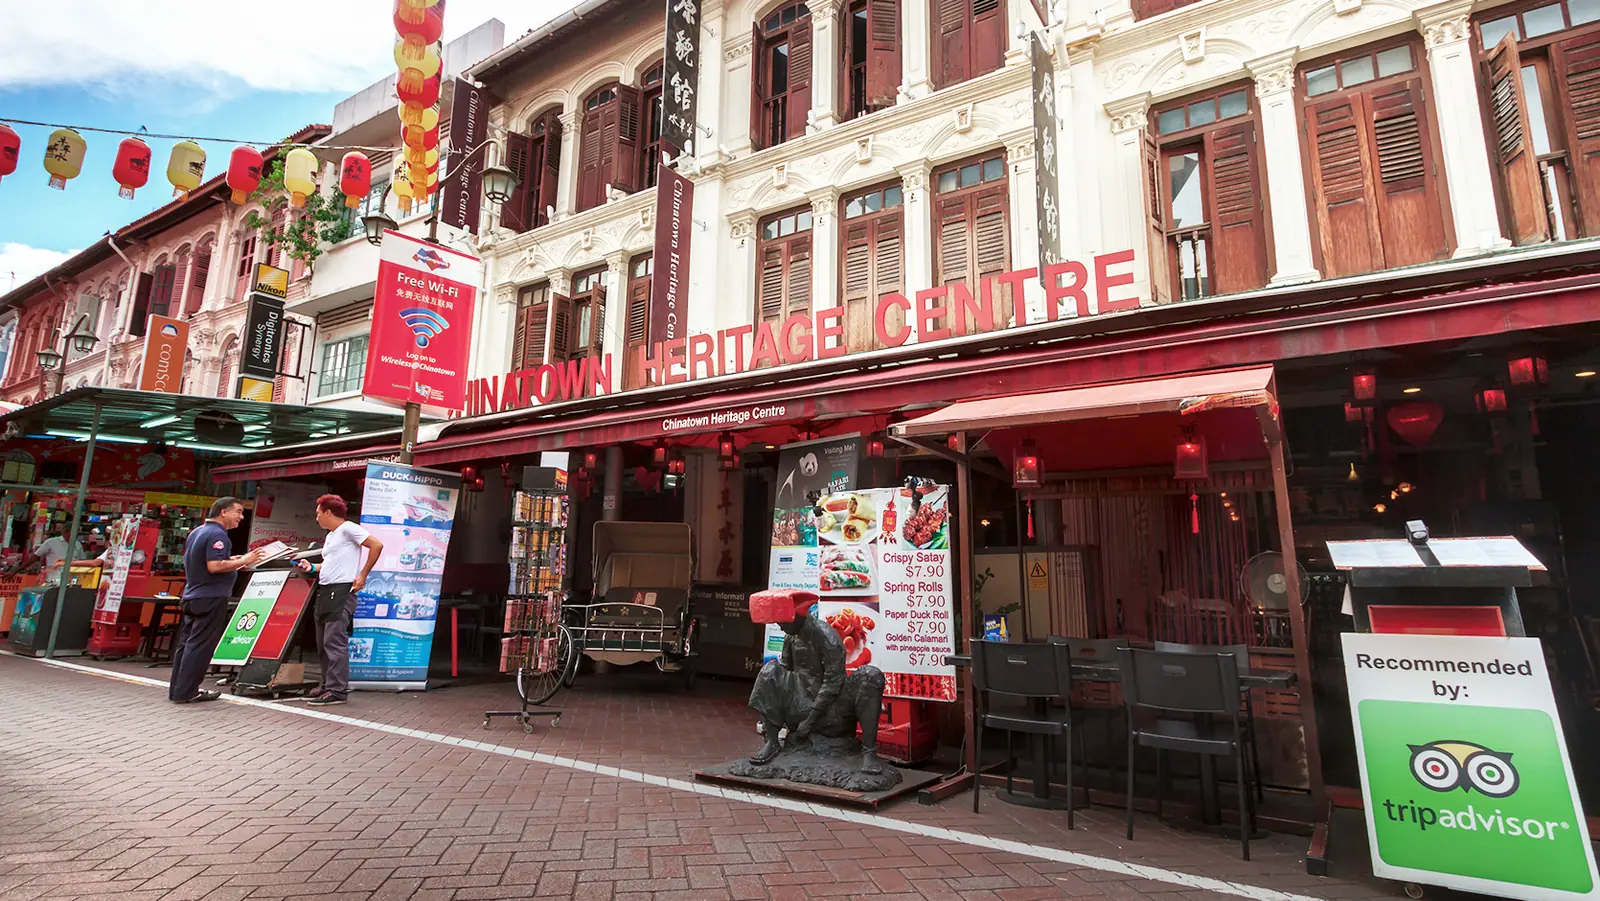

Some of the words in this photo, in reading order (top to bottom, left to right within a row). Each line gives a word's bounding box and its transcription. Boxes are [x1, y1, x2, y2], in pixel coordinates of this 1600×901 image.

[465, 89, 480, 143] Chinatown
[459, 144, 474, 189] Heitage
[458, 191, 471, 226] Centre
[671, 179, 683, 249] Chinatown
[397, 272, 425, 289] Free
[427, 279, 459, 298] Wi-Fi
[666, 252, 680, 309] Heritage
[257, 283, 285, 296] Nikon
[396, 288, 454, 311] 免费无线互联网
[262, 311, 279, 363] Digitronics
[448, 353, 612, 419] HINATOWN
[639, 306, 847, 387] HERITAGE
[875, 249, 1140, 347] CENTRE
[251, 323, 266, 360] Synergy
[406, 351, 419, 361] Log
[428, 355, 437, 364] to
[381, 355, 456, 377] Wireless@Chinatown
[662, 415, 709, 431] Chinatown
[711, 410, 750, 424] Heritage
[752, 405, 786, 419] Centre
[406, 442, 414, 453] 6
[844, 443, 856, 452] Me?
[333, 461, 348, 469] Tourist
[883, 552, 914, 566] Crispy
[916, 552, 945, 565] Satay
[905, 565, 945, 578] $7.90
[250, 579, 283, 587] Recommended
[884, 581, 916, 594] Spring
[918, 582, 943, 593] Rolls
[907, 595, 946, 608] $7.90
[885, 609, 908, 621] Paper
[910, 610, 931, 619] Duck
[933, 610, 949, 619] Roll
[907, 621, 947, 634] $7.90
[223, 634, 255, 645] tripadvisor
[885, 633, 912, 643] Golden
[914, 633, 949, 643] Calamari
[886, 644, 898, 652] with
[900, 644, 930, 653] pineapple
[932, 645, 952, 653] sauce
[909, 653, 947, 666] $7.90
[1355, 652, 1533, 677] Recommended
[1432, 680, 1470, 701] by:
